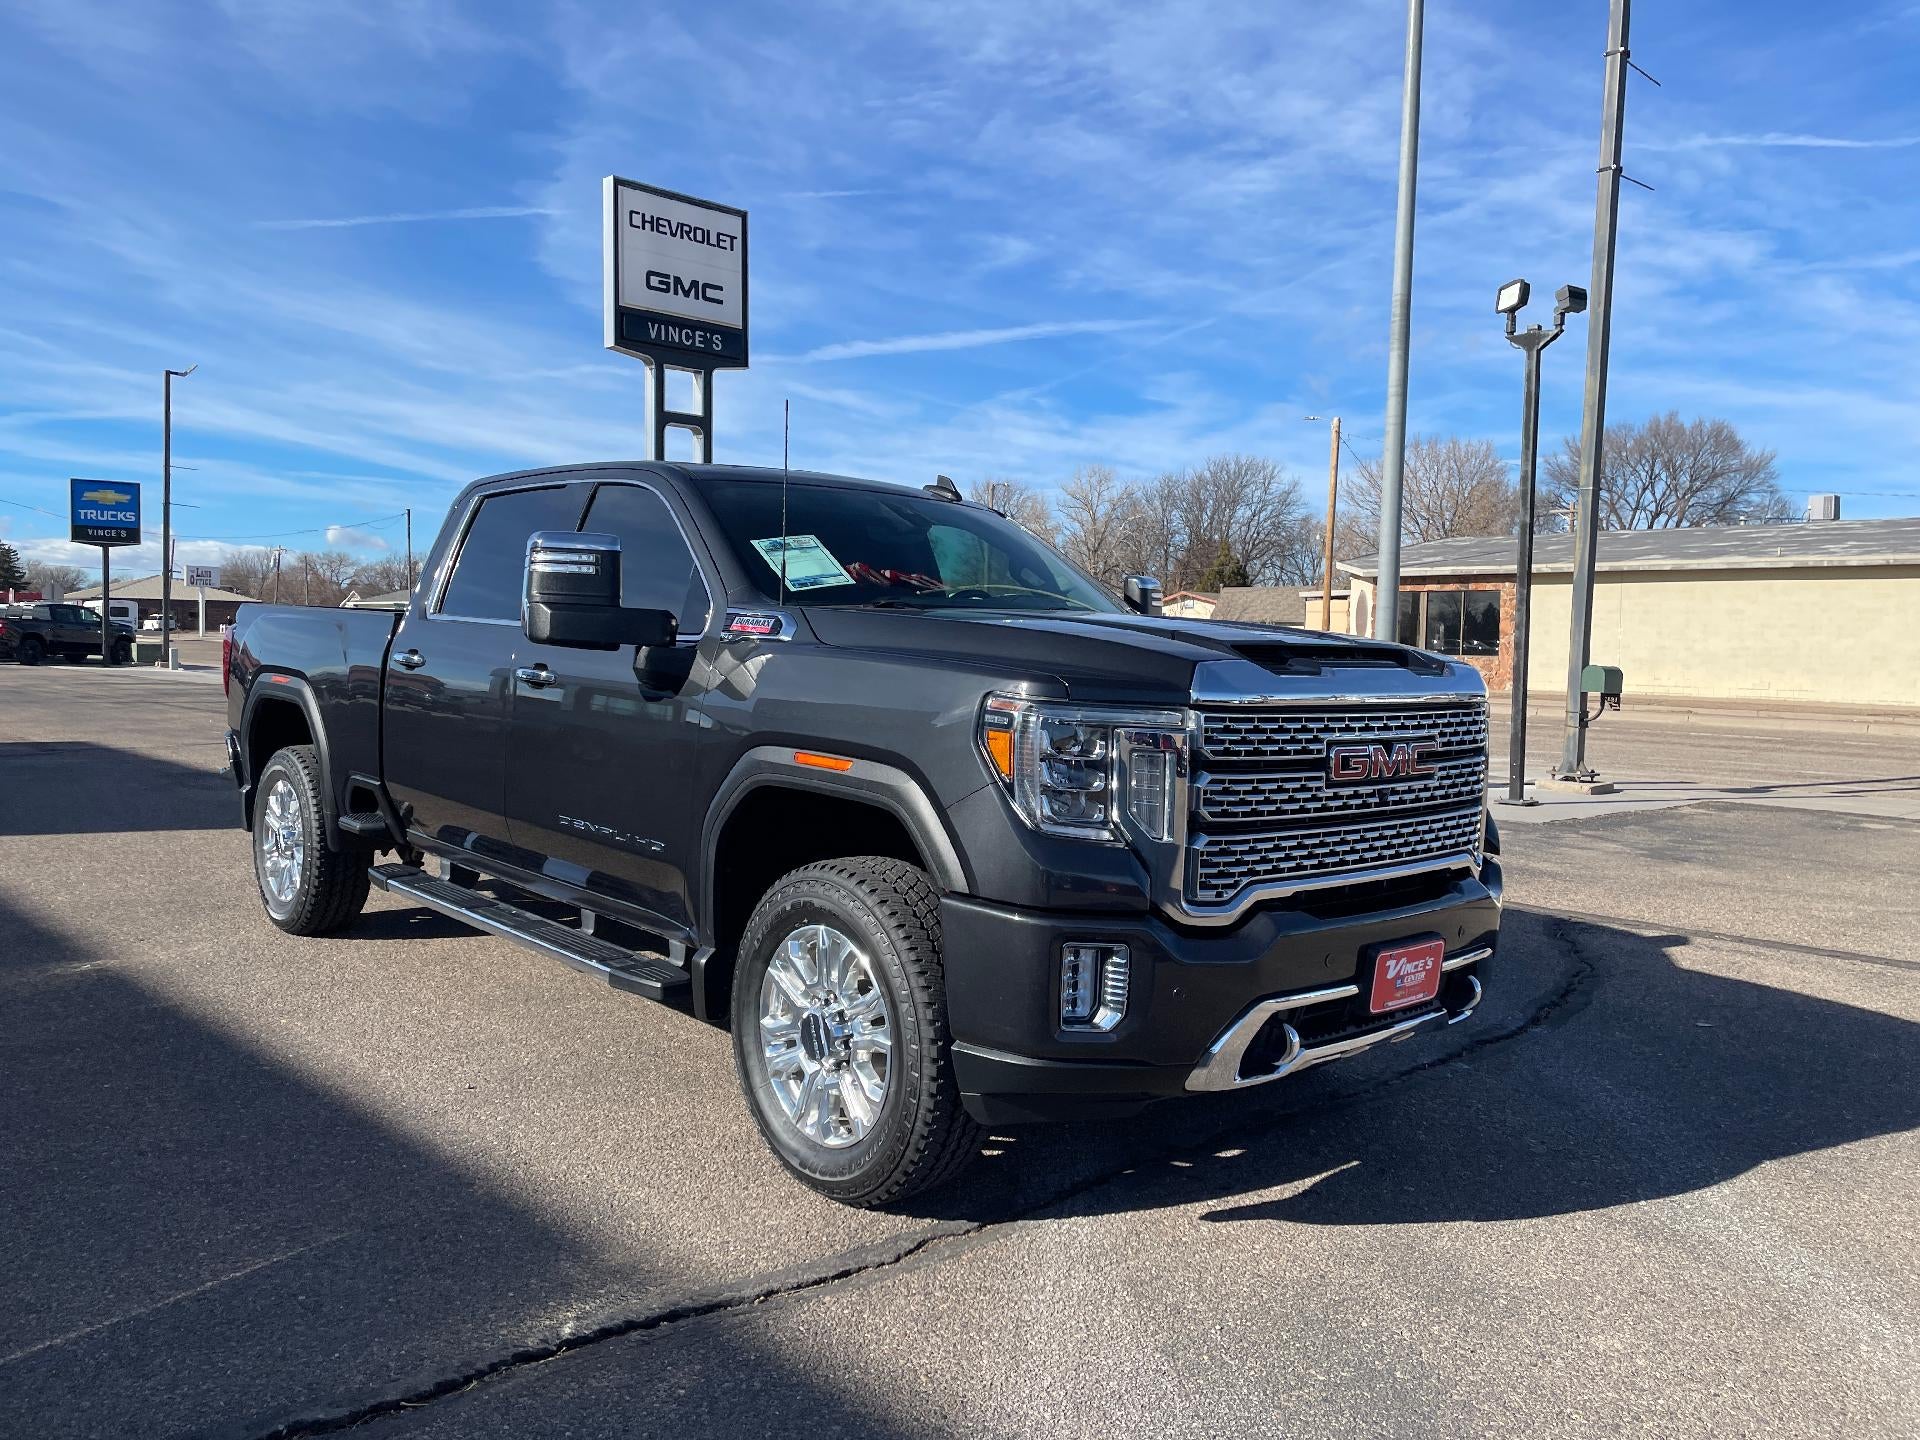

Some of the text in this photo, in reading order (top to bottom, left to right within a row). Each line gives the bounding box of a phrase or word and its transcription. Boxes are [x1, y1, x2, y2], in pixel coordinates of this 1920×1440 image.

[628, 209, 738, 252] CHEVROLET
[645, 269, 724, 305] GMC
[648, 321, 723, 351] VINCE'S
[77, 509, 136, 522] TRUCKS
[87, 528, 127, 538] VINCE'S
[735, 617, 773, 628] DURAMAX
[1331, 741, 1437, 781] GMC
[1385, 956, 1435, 980] VINCE'S
